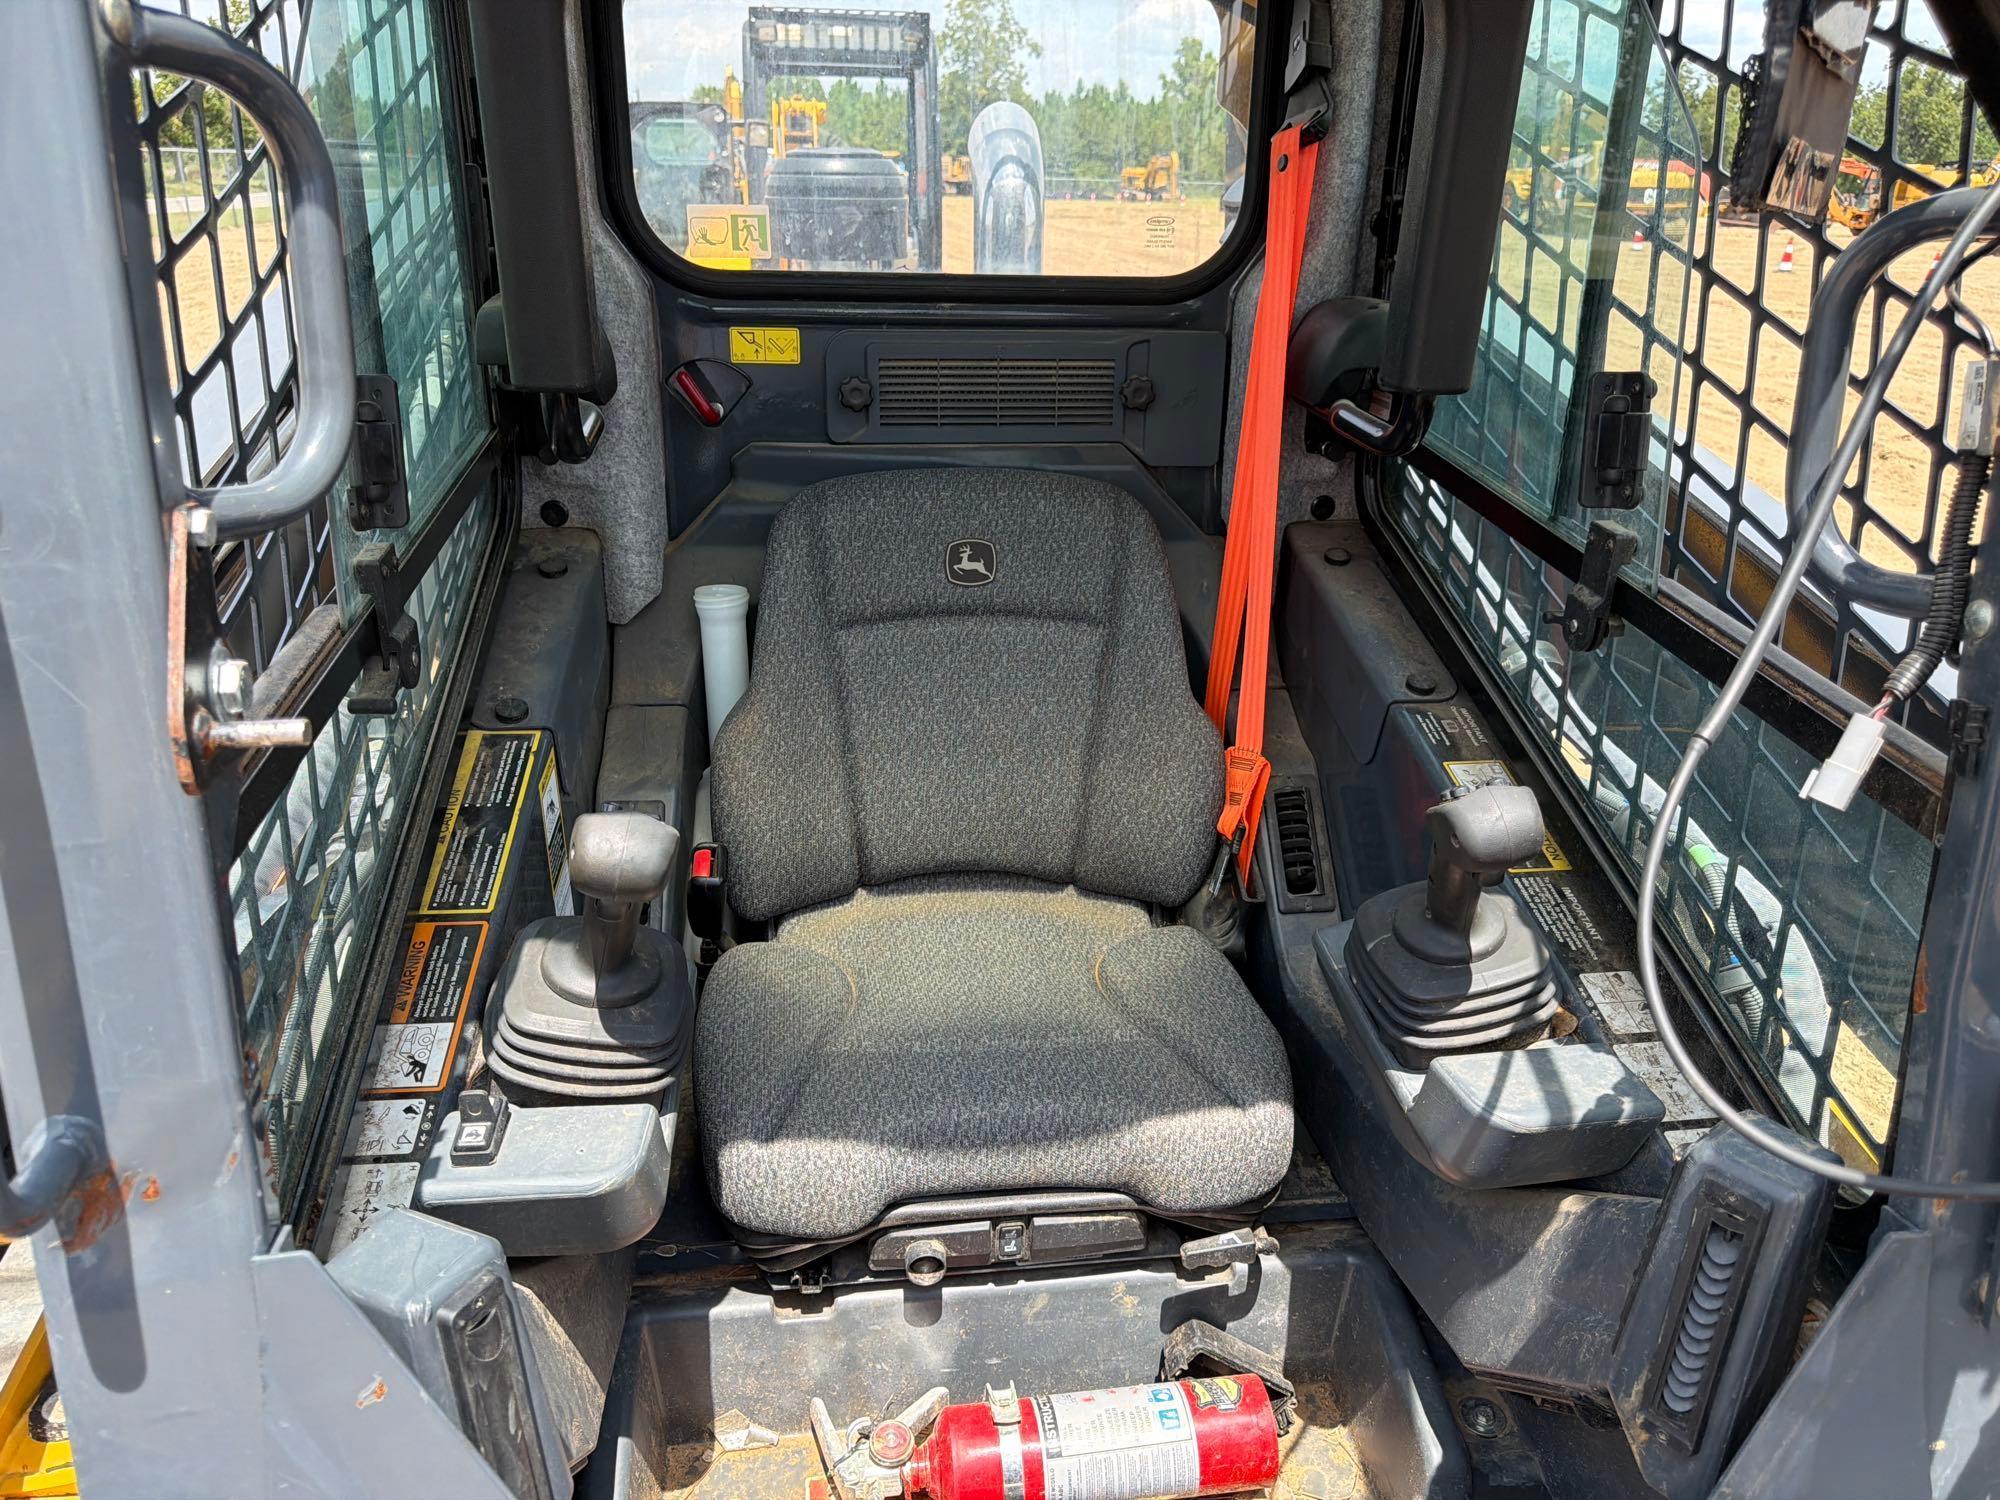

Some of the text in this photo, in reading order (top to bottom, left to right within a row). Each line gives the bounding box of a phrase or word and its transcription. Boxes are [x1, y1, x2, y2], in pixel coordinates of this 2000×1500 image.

[443, 789, 461, 831] CAUTION
[1512, 877, 1532, 902] operation
[1526, 887, 1535, 895] for
[1527, 876, 1541, 892] below
[1546, 883, 1563, 903] prevent
[1558, 903, 1577, 924] damage
[1559, 886, 1603, 940] IMPORTANT
[443, 928, 452, 937] with
[438, 938, 449, 957] machine
[395, 940, 426, 997] WARNING
[435, 957, 444, 967] this
[439, 961, 450, 978] raised.
[413, 945, 440, 1017] Always install boom lock before
[430, 967, 441, 983] around
[440, 935, 469, 1016] See Operator's Manual for complete
[436, 978, 445, 992] boom
[421, 997, 432, 1017] working
[431, 993, 441, 1008] loader
